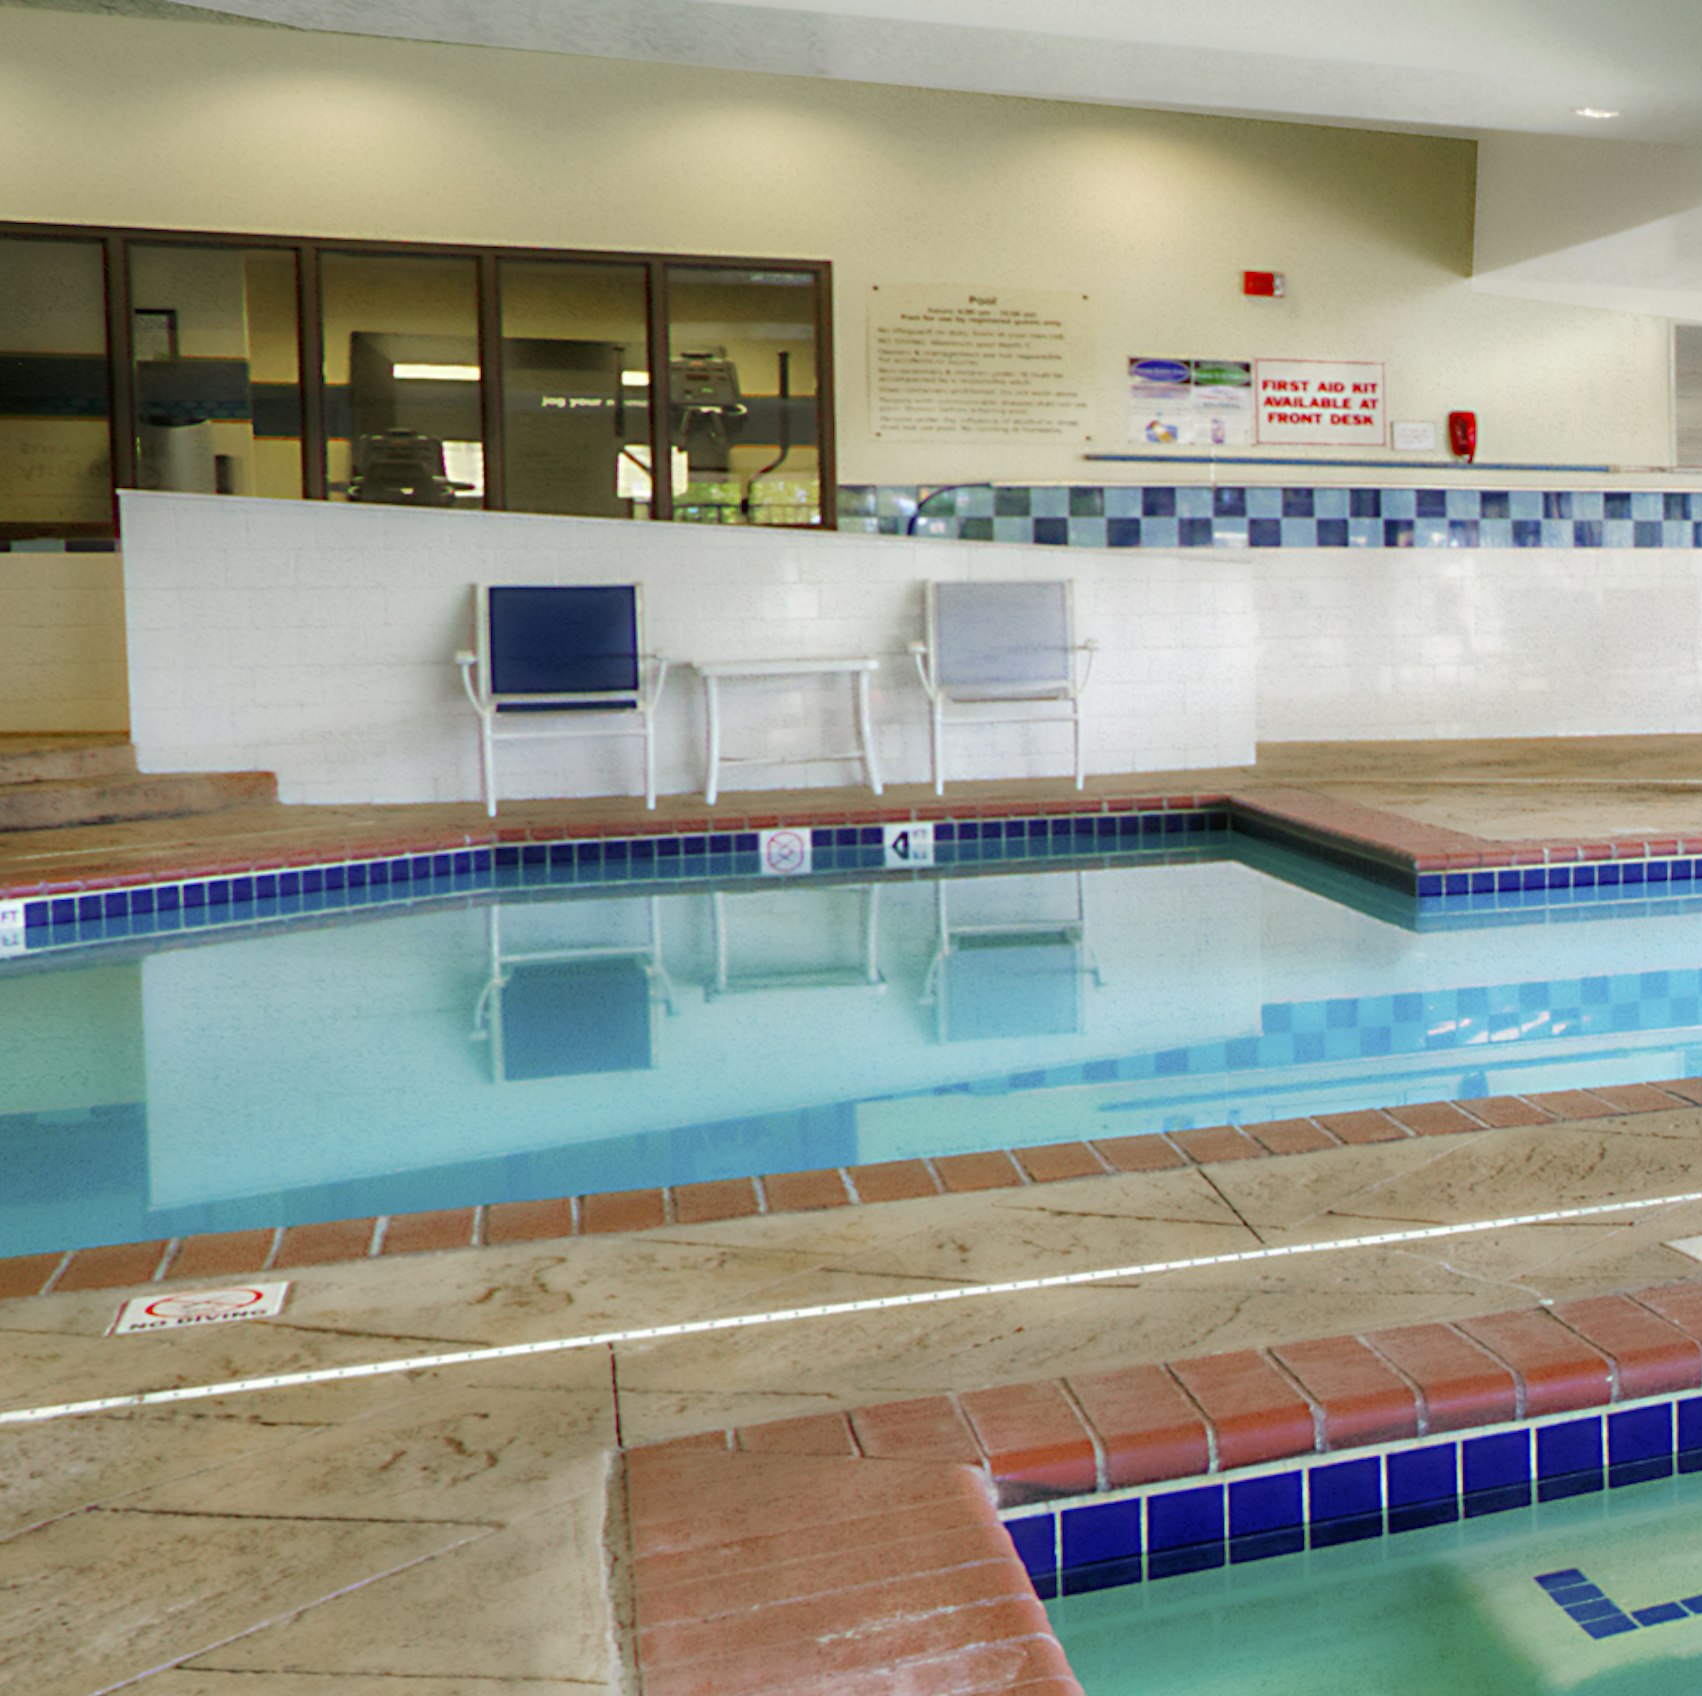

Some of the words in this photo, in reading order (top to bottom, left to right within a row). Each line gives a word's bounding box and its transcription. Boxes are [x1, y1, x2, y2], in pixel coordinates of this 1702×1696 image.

[1262, 379, 1310, 392] FIRST
[1318, 381, 1345, 393] AID
[1352, 383, 1378, 394] KIT
[1263, 397, 1352, 409] AVAILABLE
[1360, 399, 1378, 410] AT
[1267, 412, 1322, 424] FRONT
[1330, 414, 1374, 426] DESK
[129, 1320, 167, 1331] NO
[177, 1309, 267, 1325] DIVING
